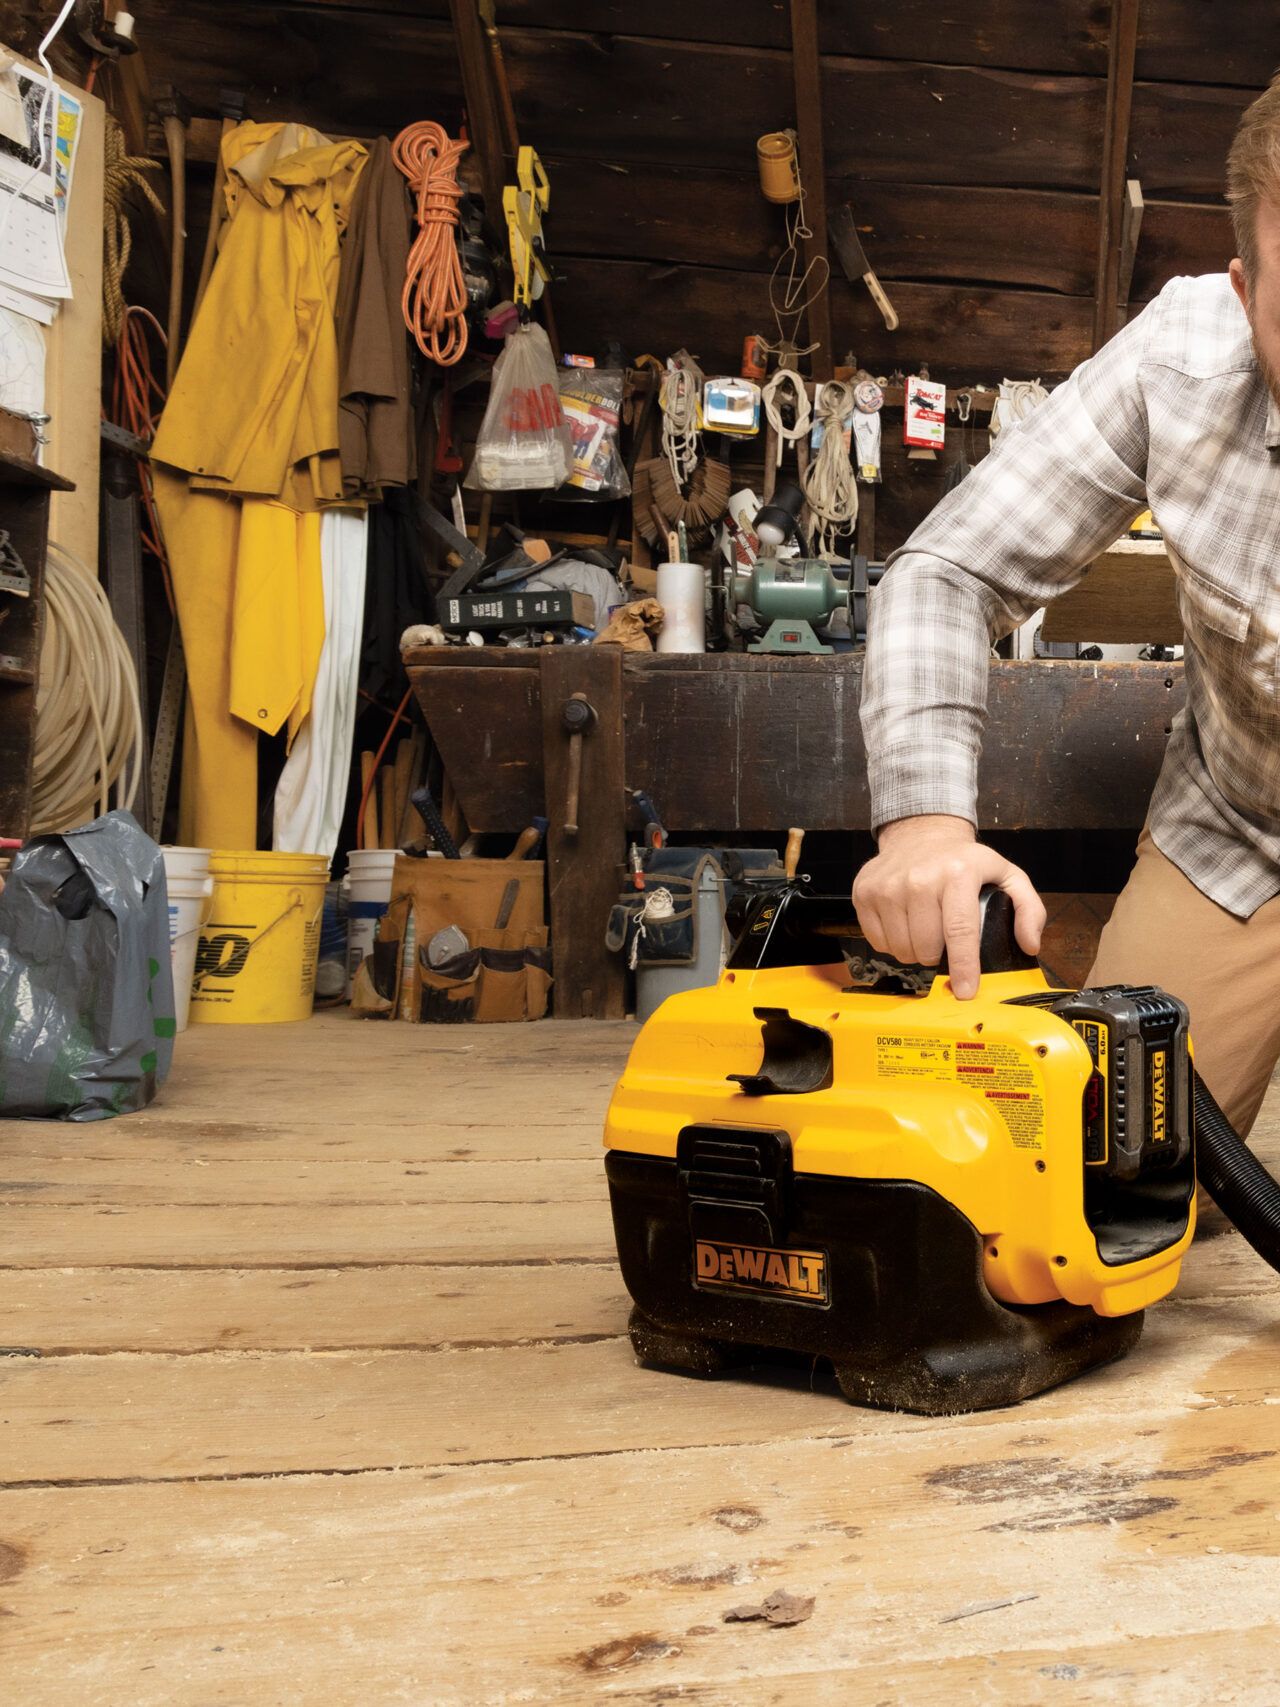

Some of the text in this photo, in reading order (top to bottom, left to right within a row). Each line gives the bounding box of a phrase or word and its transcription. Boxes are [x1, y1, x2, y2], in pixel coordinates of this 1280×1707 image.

[877, 1037, 902, 1046] DCV580
[1153, 1051, 1165, 1141] DEWALT
[696, 1243, 824, 1294] DEWALT
